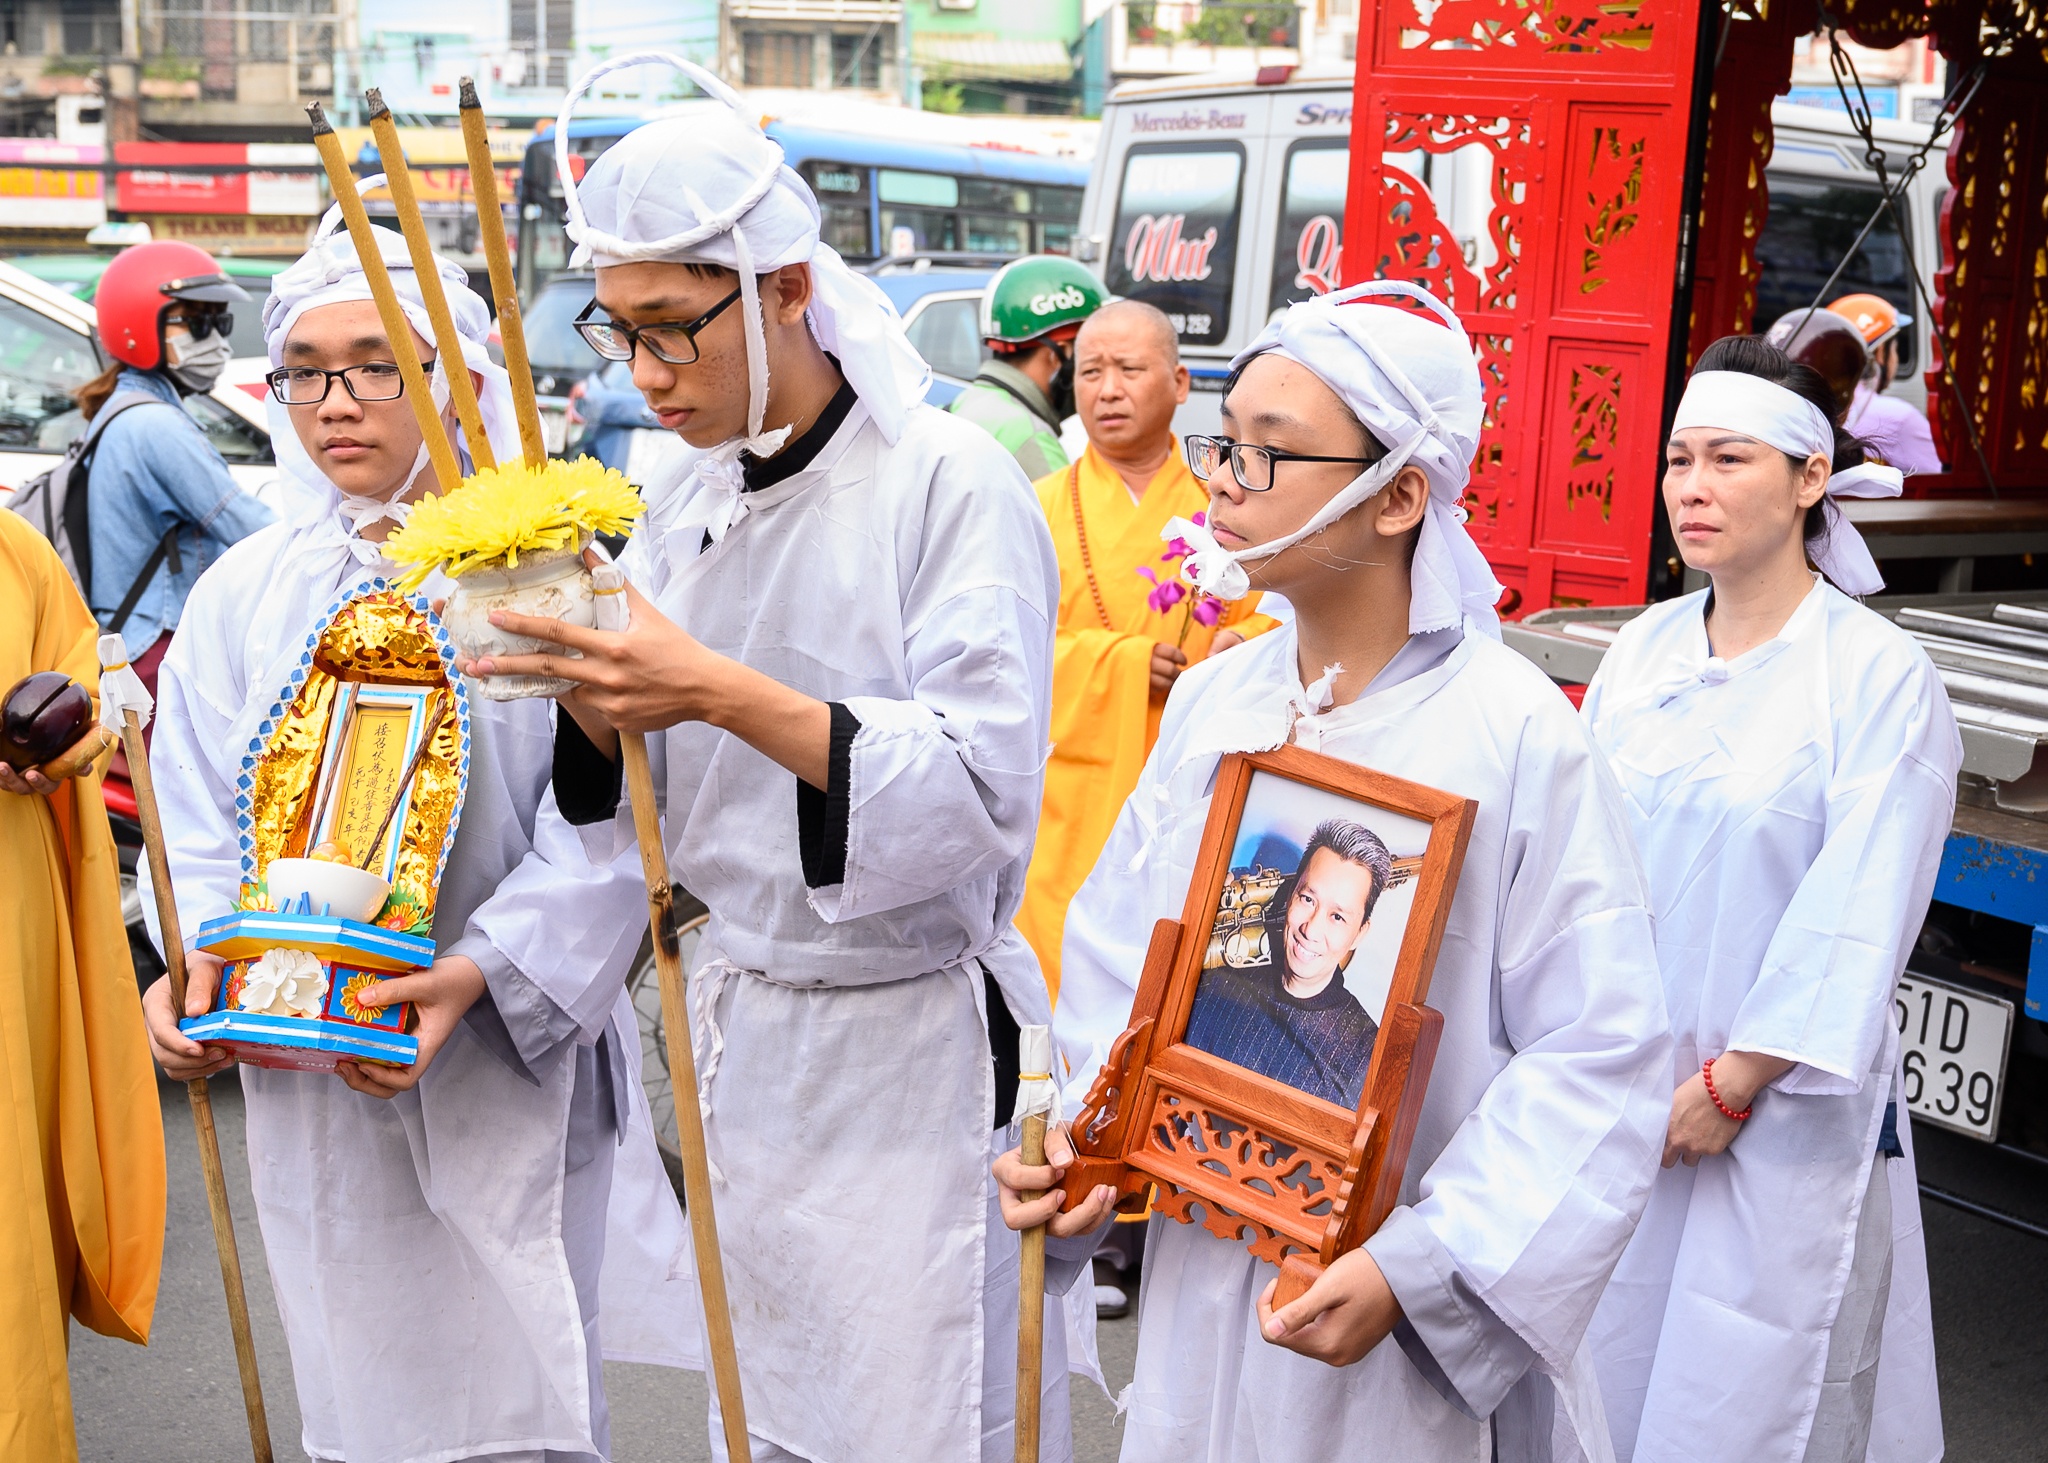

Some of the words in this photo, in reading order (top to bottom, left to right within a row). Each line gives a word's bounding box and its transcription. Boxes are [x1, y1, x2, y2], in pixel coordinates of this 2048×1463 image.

[1131, 109, 1246, 133] Mercedes-Benz
[1030, 285, 1085, 316] Grab
[1896, 985, 1969, 1054] 51D
[1904, 1050, 1993, 1126] 6.39
